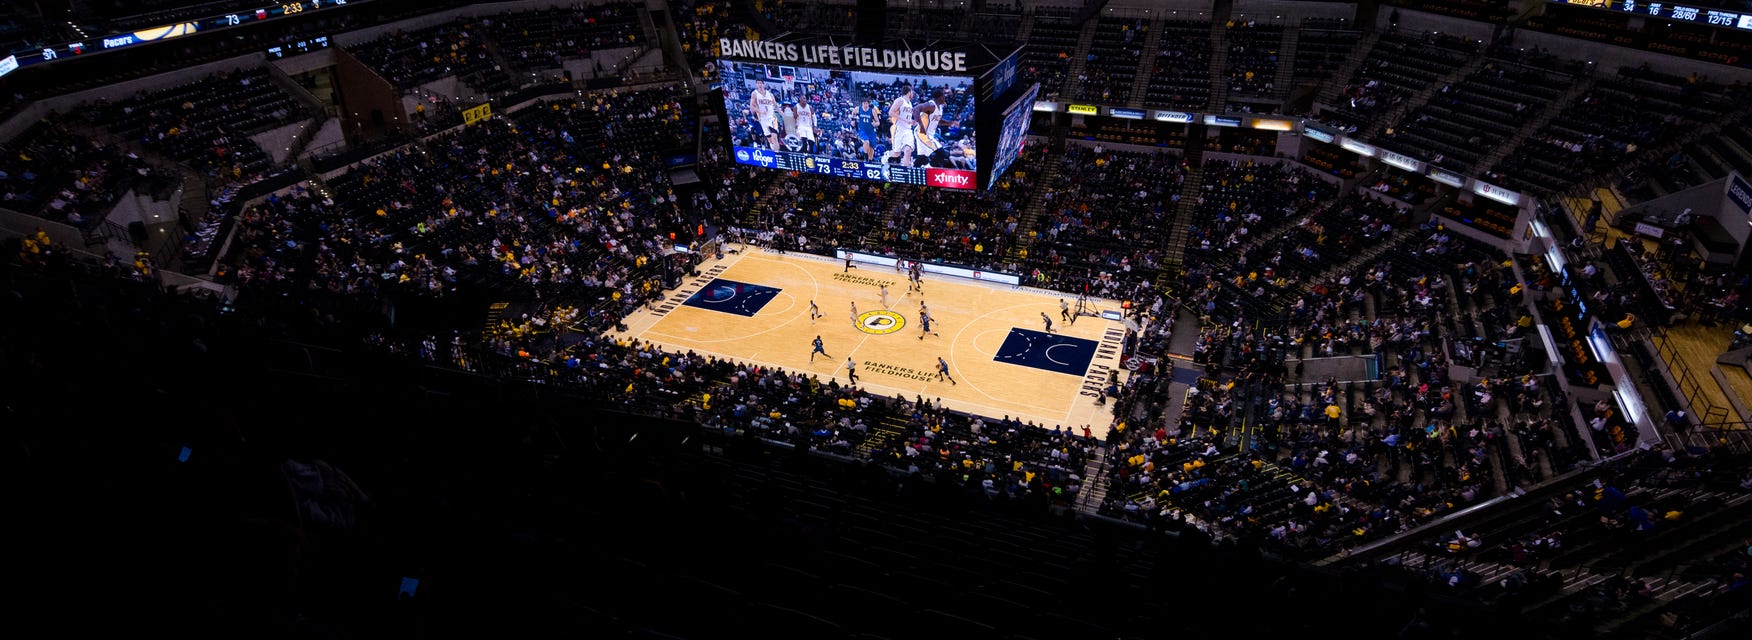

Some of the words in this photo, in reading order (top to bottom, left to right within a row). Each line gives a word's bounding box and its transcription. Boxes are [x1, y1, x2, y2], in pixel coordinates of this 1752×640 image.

[282, 2, 303, 15] 2:33
[1623, 4, 1634, 12] 34
[1649, 7, 1660, 16] 16
[225, 14, 240, 26] 73
[1671, 10, 1697, 21] 28/60
[1707, 15, 1733, 26] 12/15
[103, 36, 133, 48] Pacers
[720, 38, 799, 62] BANKERS
[802, 45, 842, 65] LIFE
[843, 47, 967, 72] FIELDHOUSE
[1070, 104, 1096, 112] STANLEY
[1156, 112, 1187, 120] DEFENDER
[752, 149, 774, 167] Kroger
[817, 163, 831, 174] 73
[842, 161, 859, 169] 2:33
[866, 169, 881, 179] 62
[1730, 183, 1752, 207] LEGENDS
[833, 272, 876, 283] BANKERS
[650, 289, 696, 317] INDIANA
[689, 264, 728, 288] PACERS
[1095, 327, 1125, 360] INDIANA
[864, 360, 915, 375] BANKERS
[917, 370, 941, 379] LIFE
[864, 365, 934, 382] FIELDHOUSE
[1079, 363, 1110, 398] PACERS
